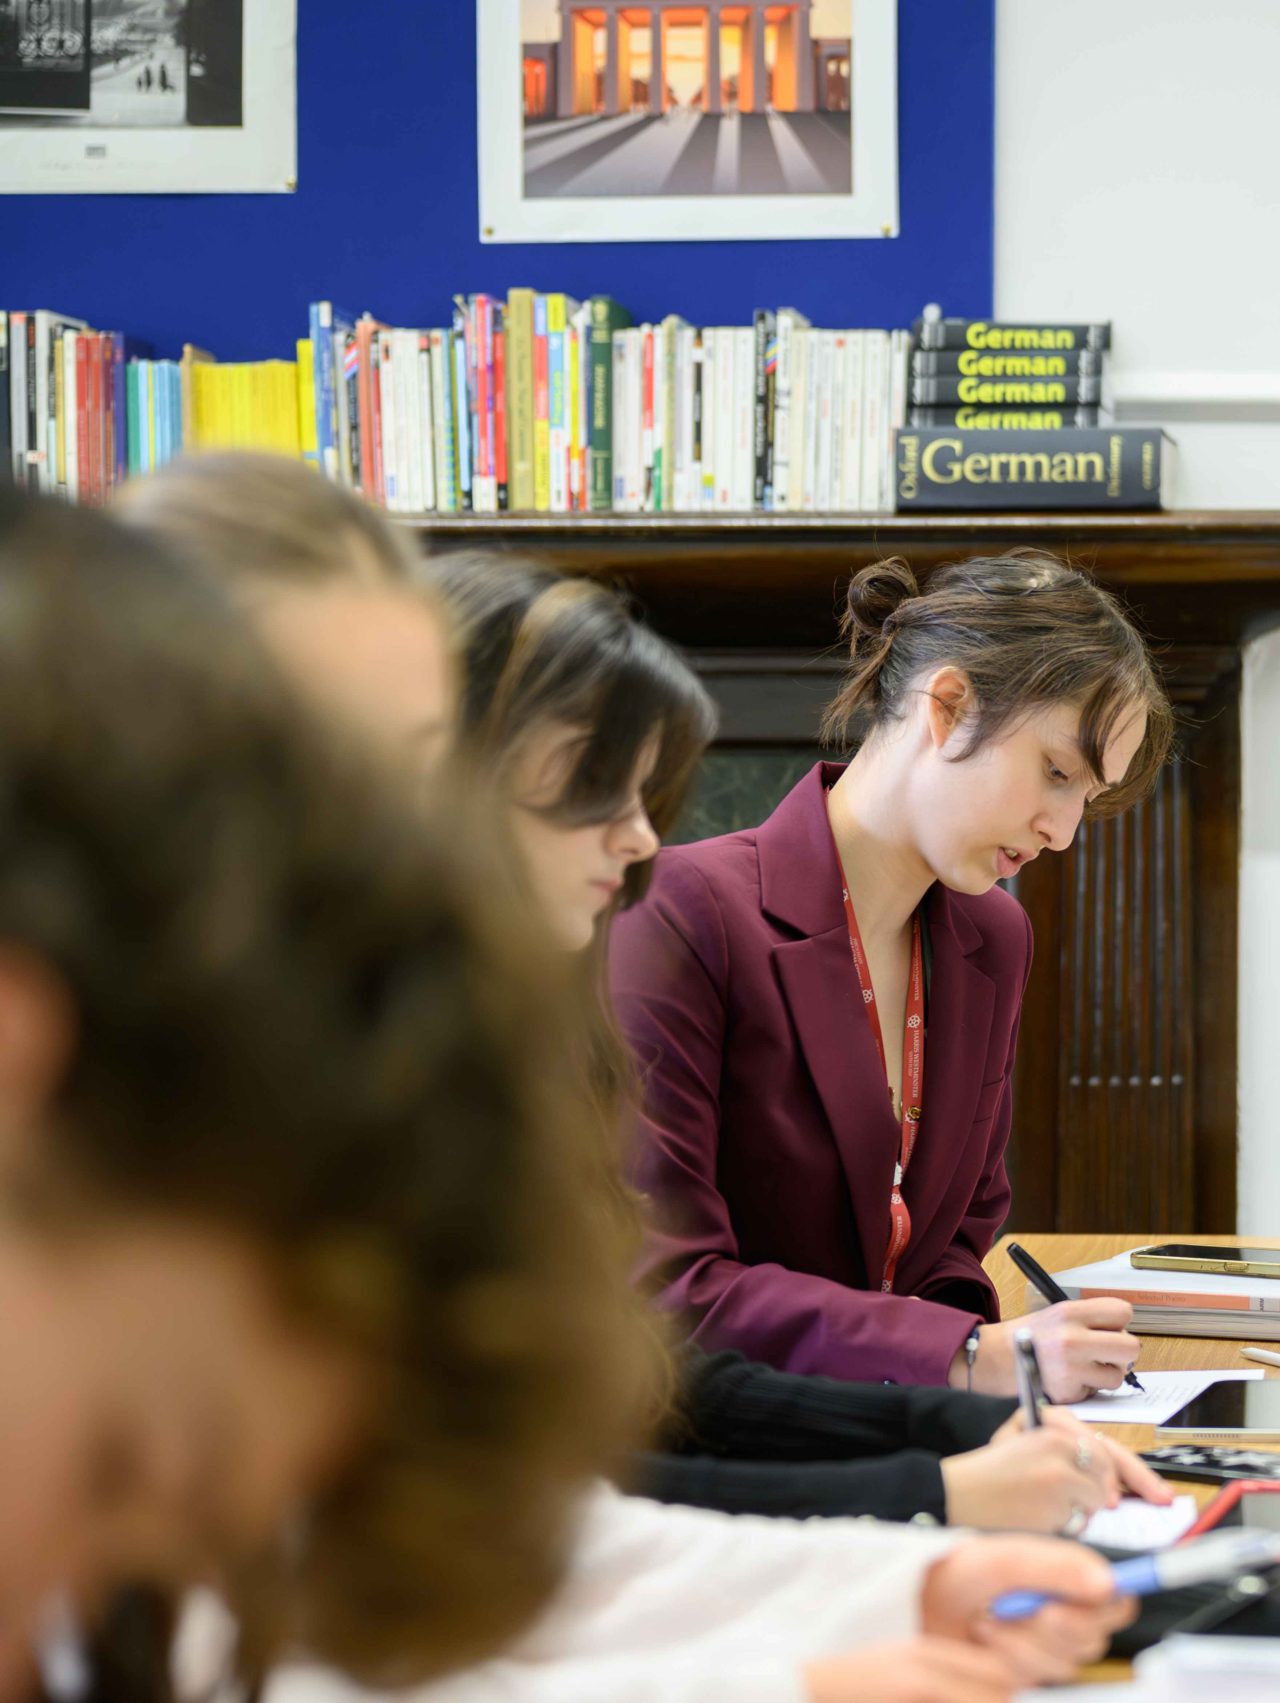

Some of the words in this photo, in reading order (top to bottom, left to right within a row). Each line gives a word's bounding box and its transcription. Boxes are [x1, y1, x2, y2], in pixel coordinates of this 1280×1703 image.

[966, 322, 1075, 350] German
[958, 351, 1067, 376] German
[957, 377, 1066, 403] German
[955, 407, 1063, 430] German
[899, 436, 920, 500] Oxford
[922, 437, 1105, 485] German
[911, 1053, 919, 1098] WESTMINSTER
